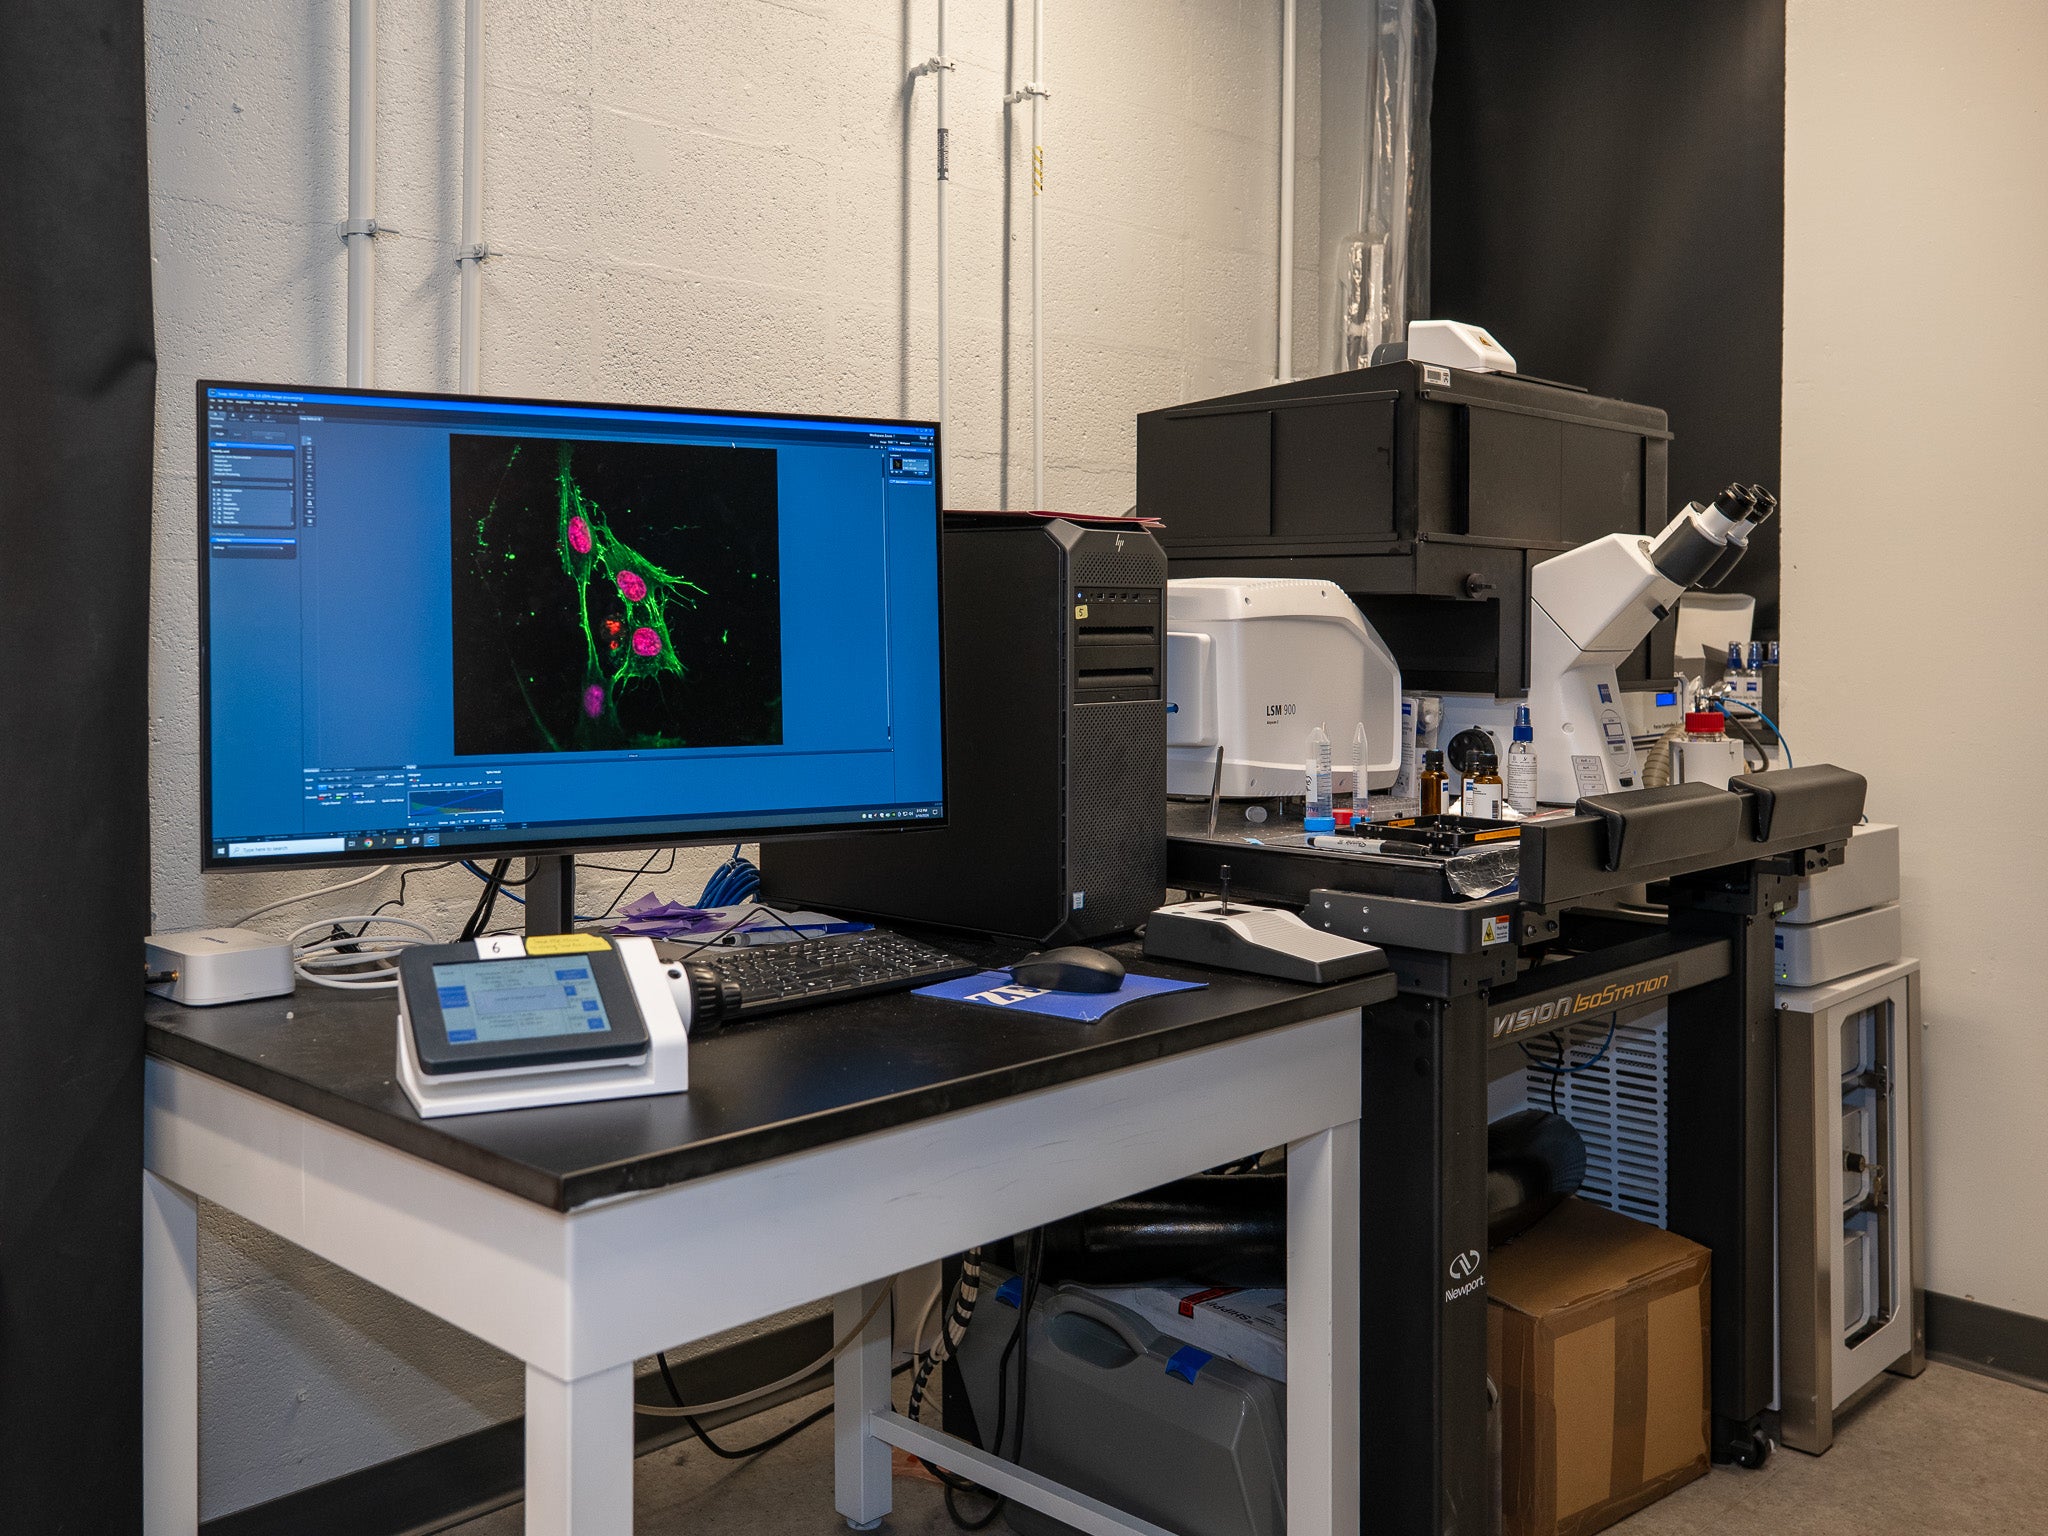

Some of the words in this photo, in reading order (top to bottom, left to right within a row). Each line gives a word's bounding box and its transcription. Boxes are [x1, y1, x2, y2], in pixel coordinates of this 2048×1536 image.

[1267, 705, 1282, 716] LSM
[1283, 704, 1297, 716] 900
[492, 942, 501, 953] 6
[1493, 996, 1573, 1038] VISION
[1445, 1275, 1485, 1303] Newport
